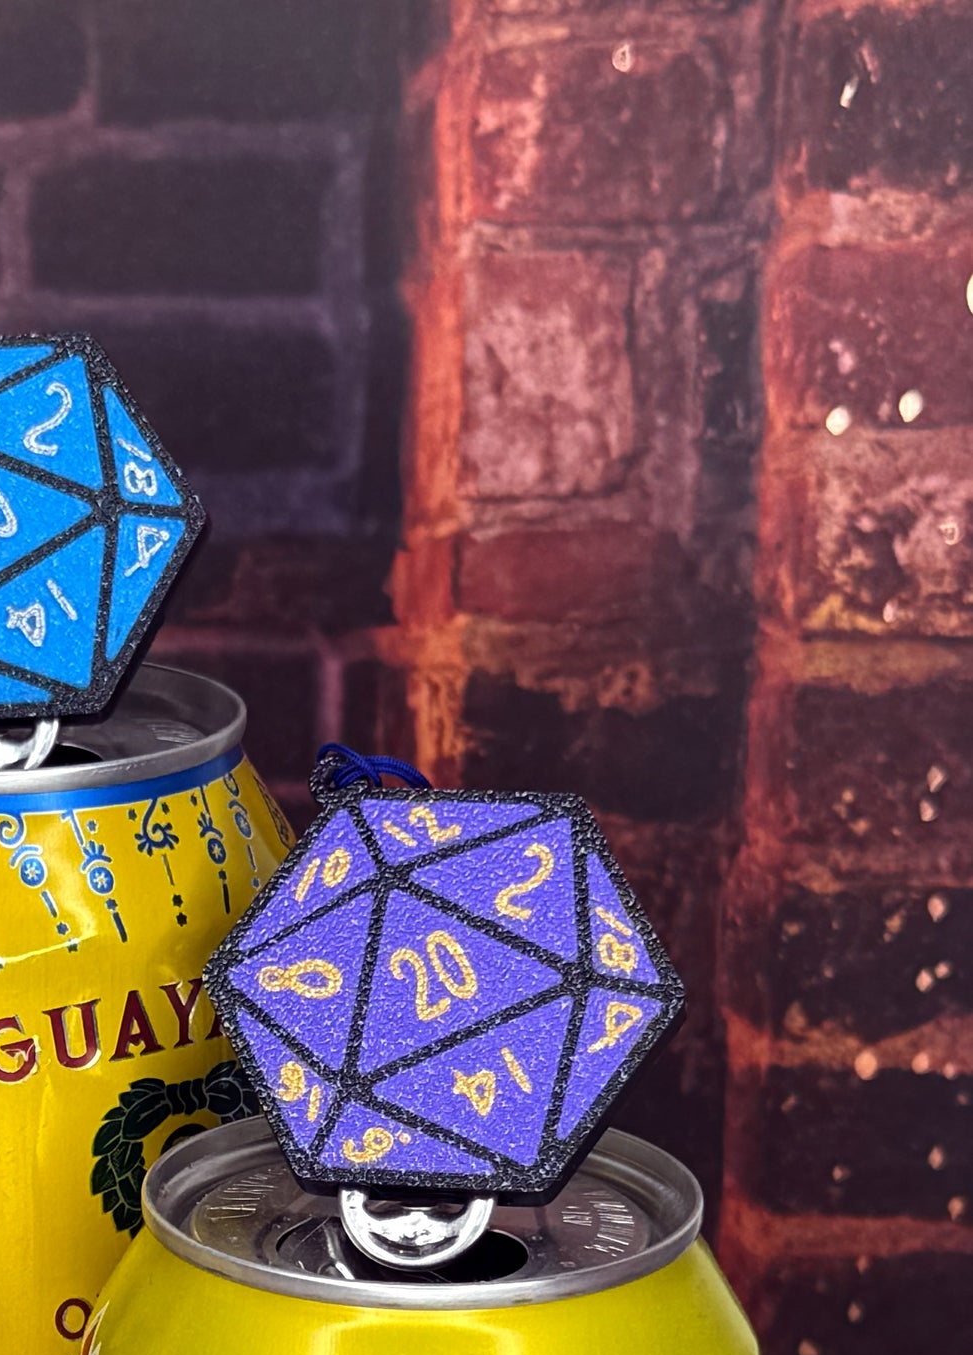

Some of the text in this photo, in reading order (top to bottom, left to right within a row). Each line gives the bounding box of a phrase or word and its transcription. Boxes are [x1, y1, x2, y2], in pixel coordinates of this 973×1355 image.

[23, 382, 73, 456] 2
[5, 578, 78, 648] 14
[381, 805, 463, 848] 12
[293, 847, 353, 903] 10
[494, 841, 556, 922] 2
[594, 904, 639, 973] 18
[255, 957, 345, 1000] 8
[388, 928, 479, 1023] 20
[451, 1045, 534, 1117] 14
